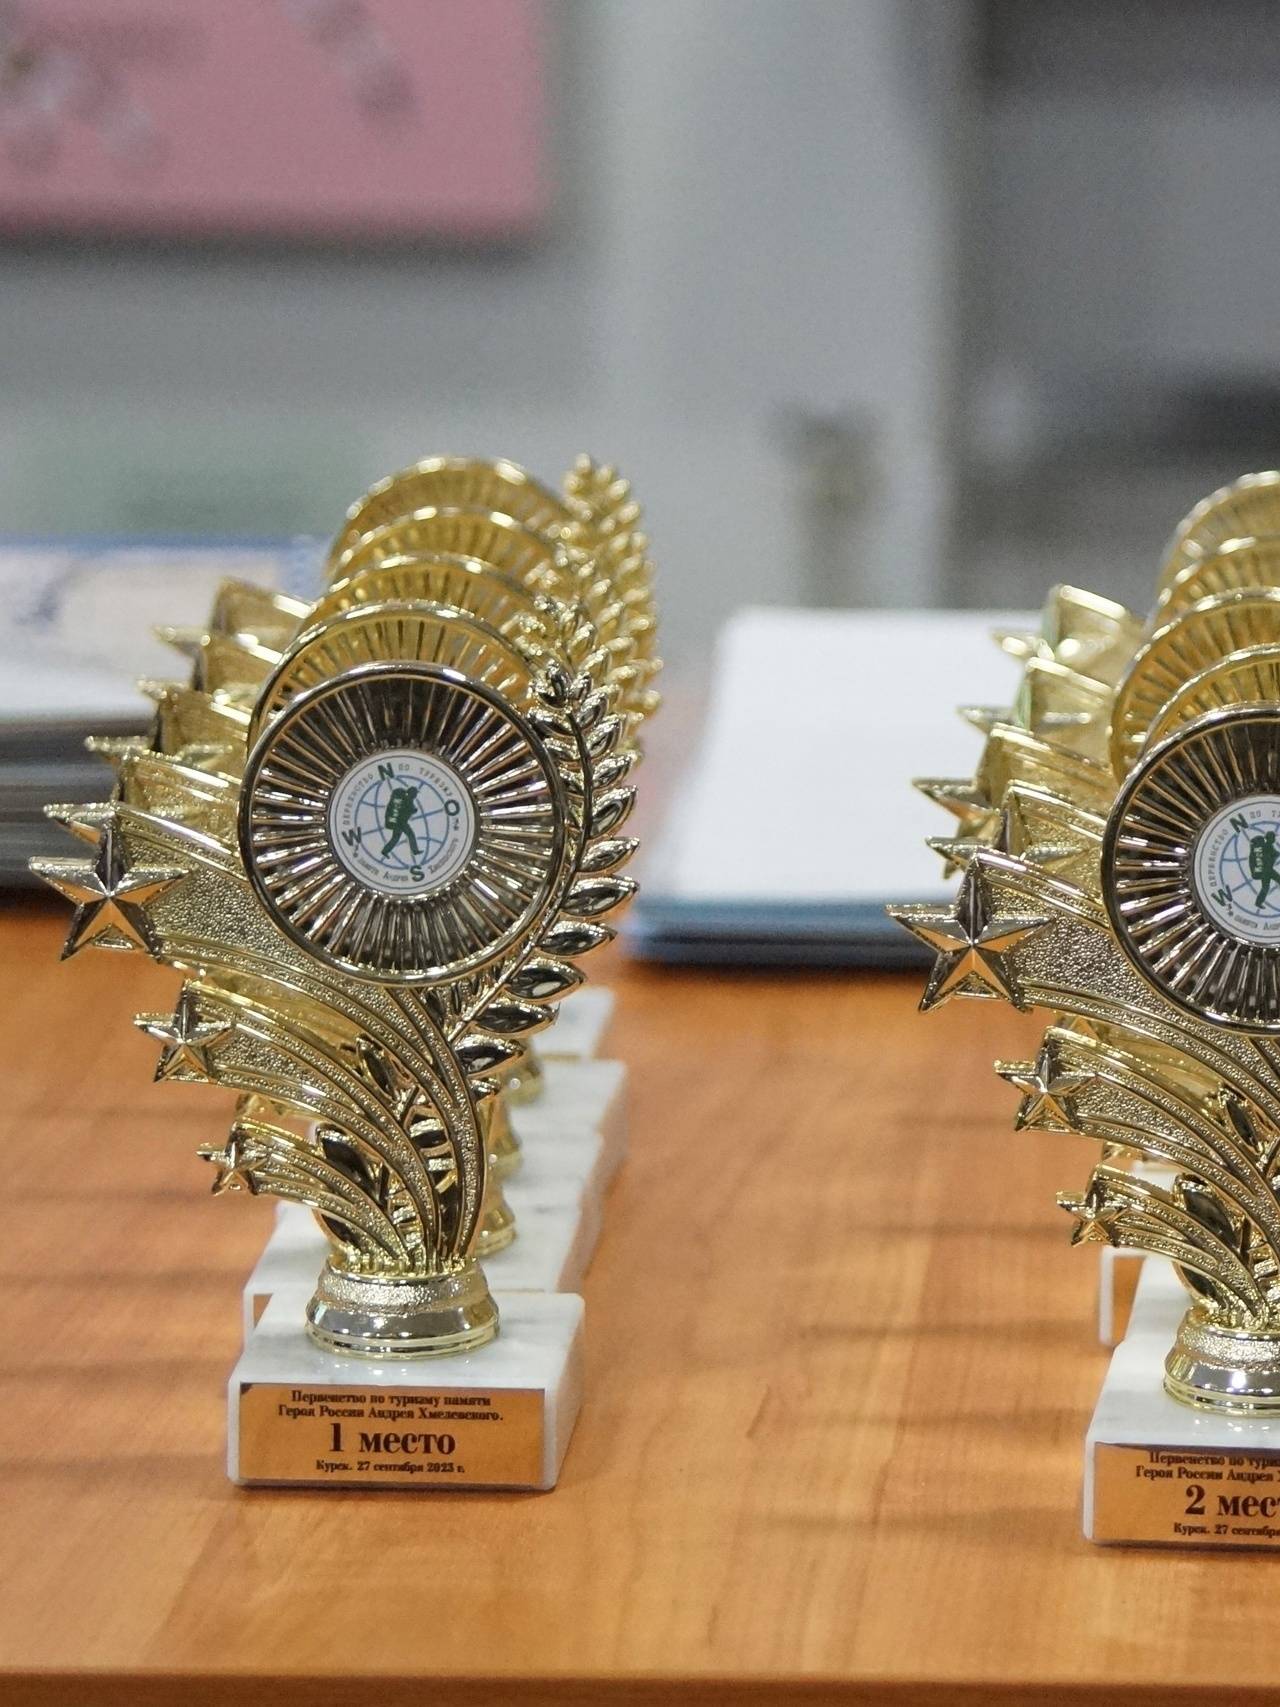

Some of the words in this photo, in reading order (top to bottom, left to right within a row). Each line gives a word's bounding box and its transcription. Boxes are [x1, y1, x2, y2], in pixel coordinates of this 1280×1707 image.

[378, 762, 394, 780] N
[1230, 813, 1248, 833] N
[342, 826, 362, 846] W
[410, 865, 425, 882] S
[1211, 884, 1232, 907] W
[292, 1390, 366, 1406] Первенство
[370, 1394, 384, 1404] по
[388, 1394, 440, 1408] туризму
[444, 1395, 491, 1406] памяти
[278, 1405, 315, 1418] Героя
[319, 1406, 364, 1418] России
[368, 1408, 414, 1422] Андрея
[329, 1422, 343, 1452] 1
[360, 1432, 456, 1455] место
[358, 1461, 370, 1471] 27
[373, 1461, 423, 1474] сентября
[1150, 1452, 1224, 1466] Первенство
[1228, 1456, 1244, 1466] по
[1136, 1466, 1173, 1480] Героя
[1178, 1467, 1223, 1480] России
[1227, 1469, 1274, 1484] Андрея
[1185, 1484, 1205, 1515] 2
[1214, 1524, 1228, 1534] 27
